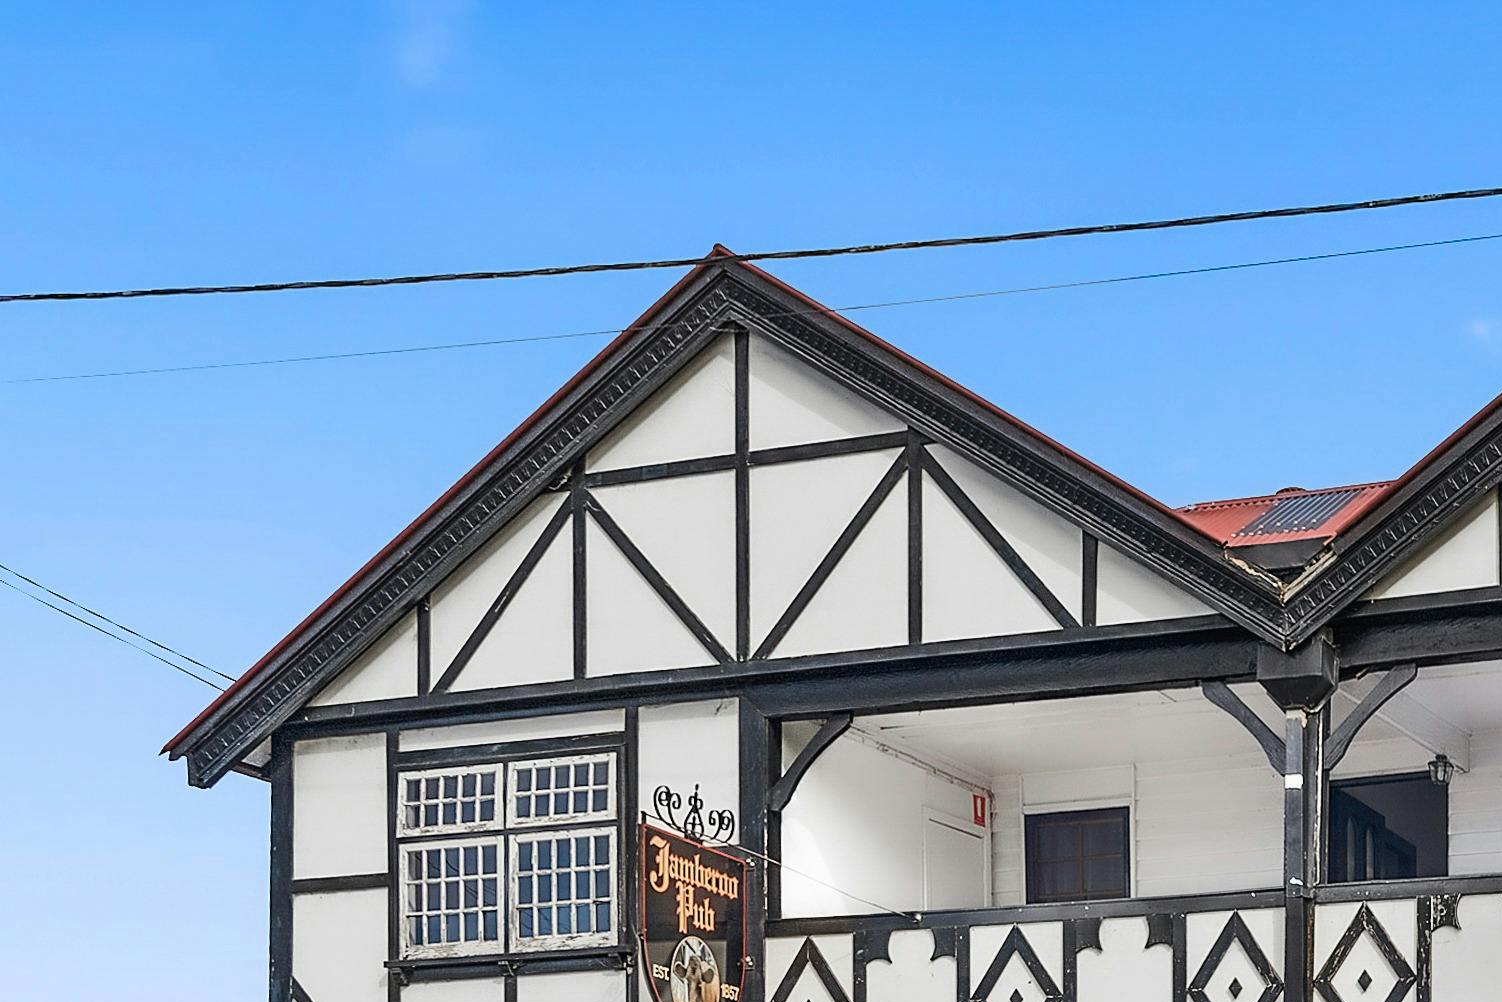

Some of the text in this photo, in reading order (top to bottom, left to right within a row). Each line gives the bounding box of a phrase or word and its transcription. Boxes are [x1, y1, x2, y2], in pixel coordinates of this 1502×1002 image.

[650, 835, 740, 899] Jamberoo
[675, 881, 717, 934] Pub
[652, 963, 671, 982] EST.
[720, 983, 740, 1001] 1857
